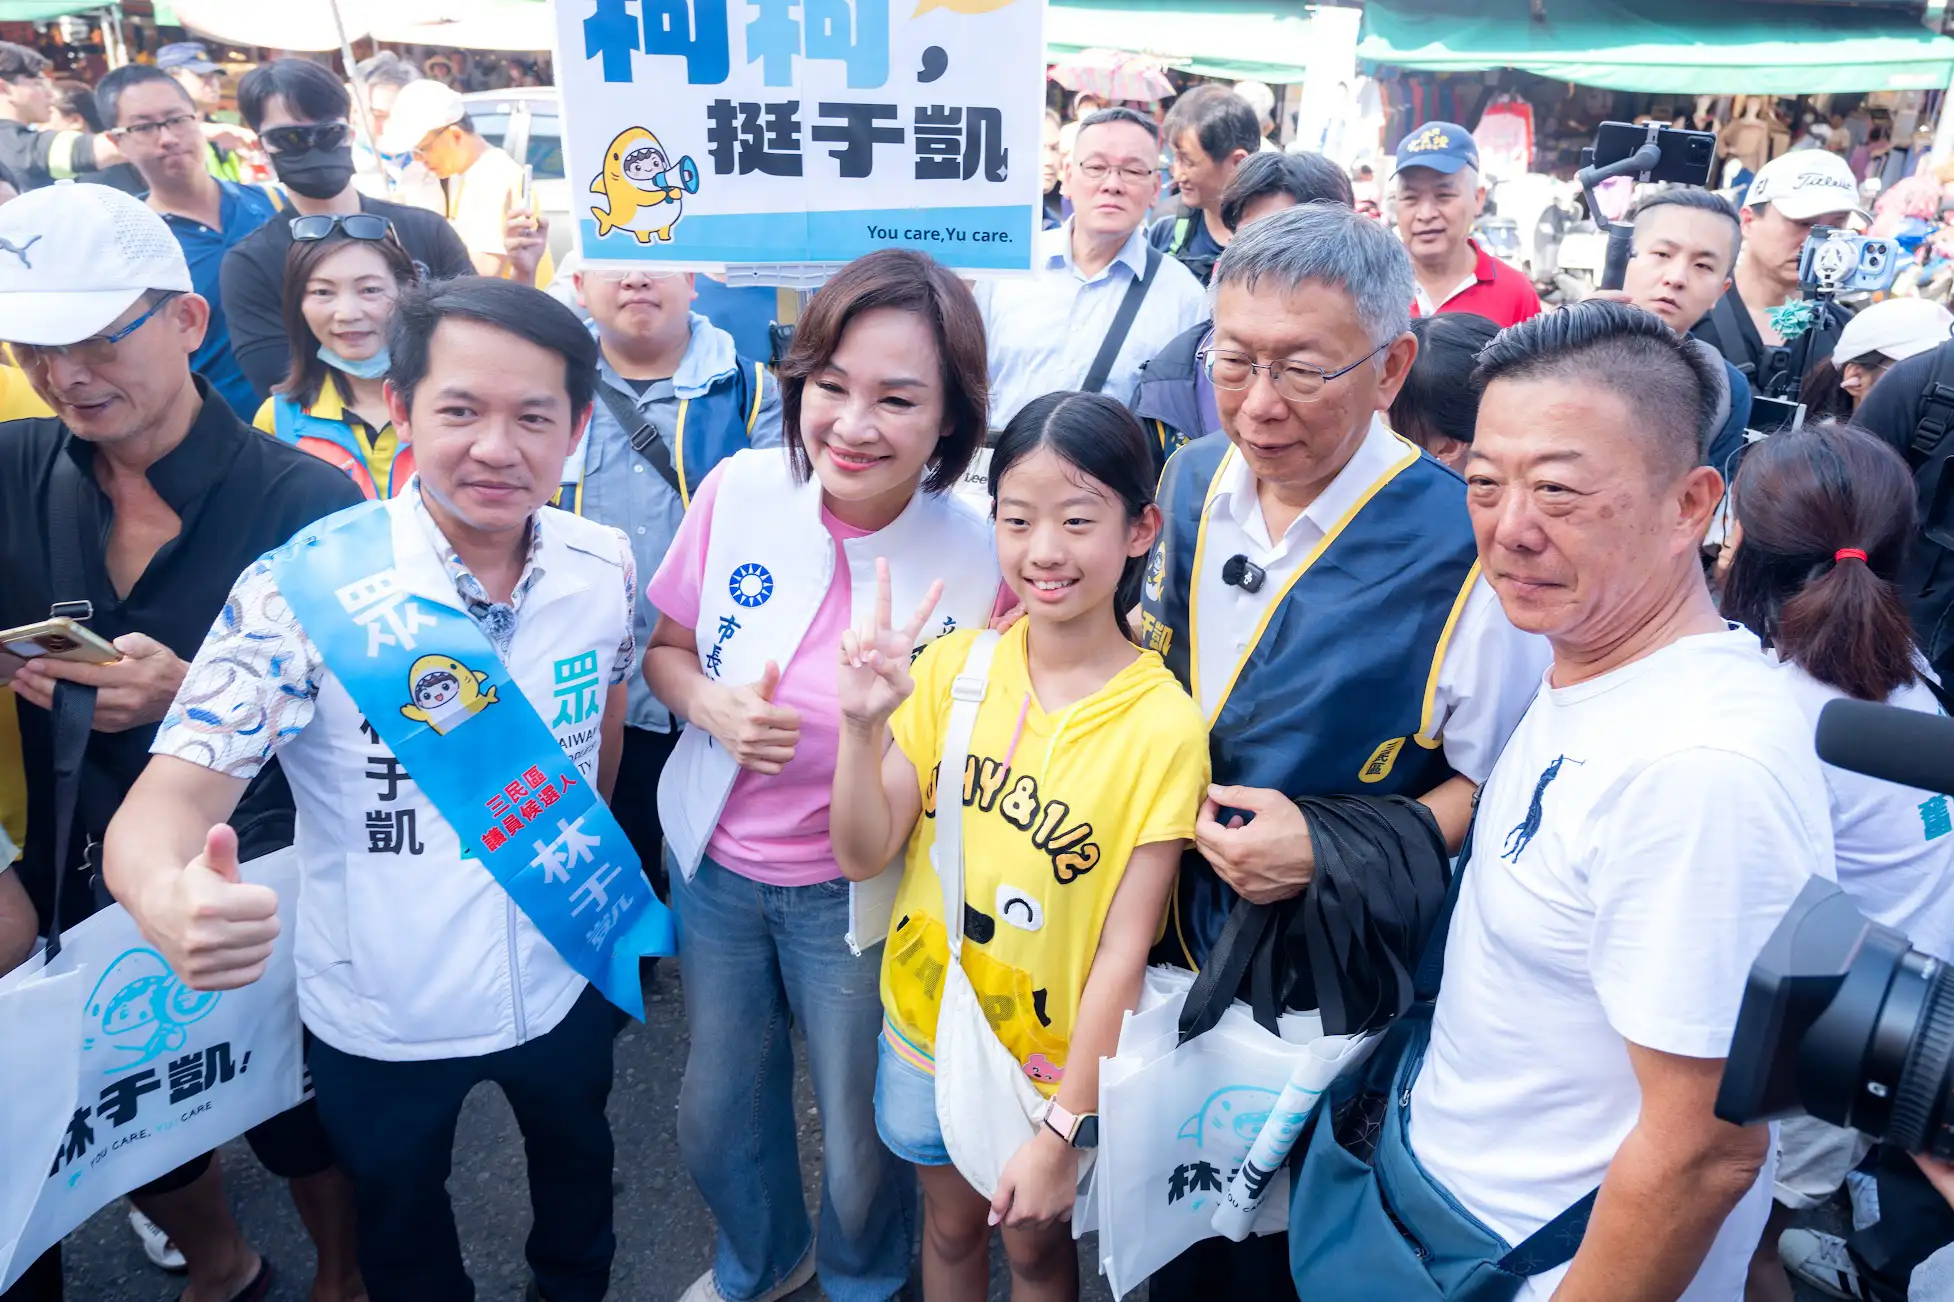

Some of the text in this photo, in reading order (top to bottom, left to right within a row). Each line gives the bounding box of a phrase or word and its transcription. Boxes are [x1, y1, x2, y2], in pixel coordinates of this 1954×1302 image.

[707, 99, 1009, 182] 挺于凱
[867, 225, 898, 240] You
[972, 231, 1013, 243] care.
[334, 566, 437, 658] 眾
[706, 614, 741, 681] 市長
[552, 649, 599, 729] 眾
[559, 726, 598, 749] AIWA
[480, 774, 577, 853] 議員候選人
[485, 764, 548, 819] 三民區
[90, 1148, 108, 1169] YOU
[181, 1101, 212, 1122] CARE
[1168, 1160, 1240, 1206] 林
